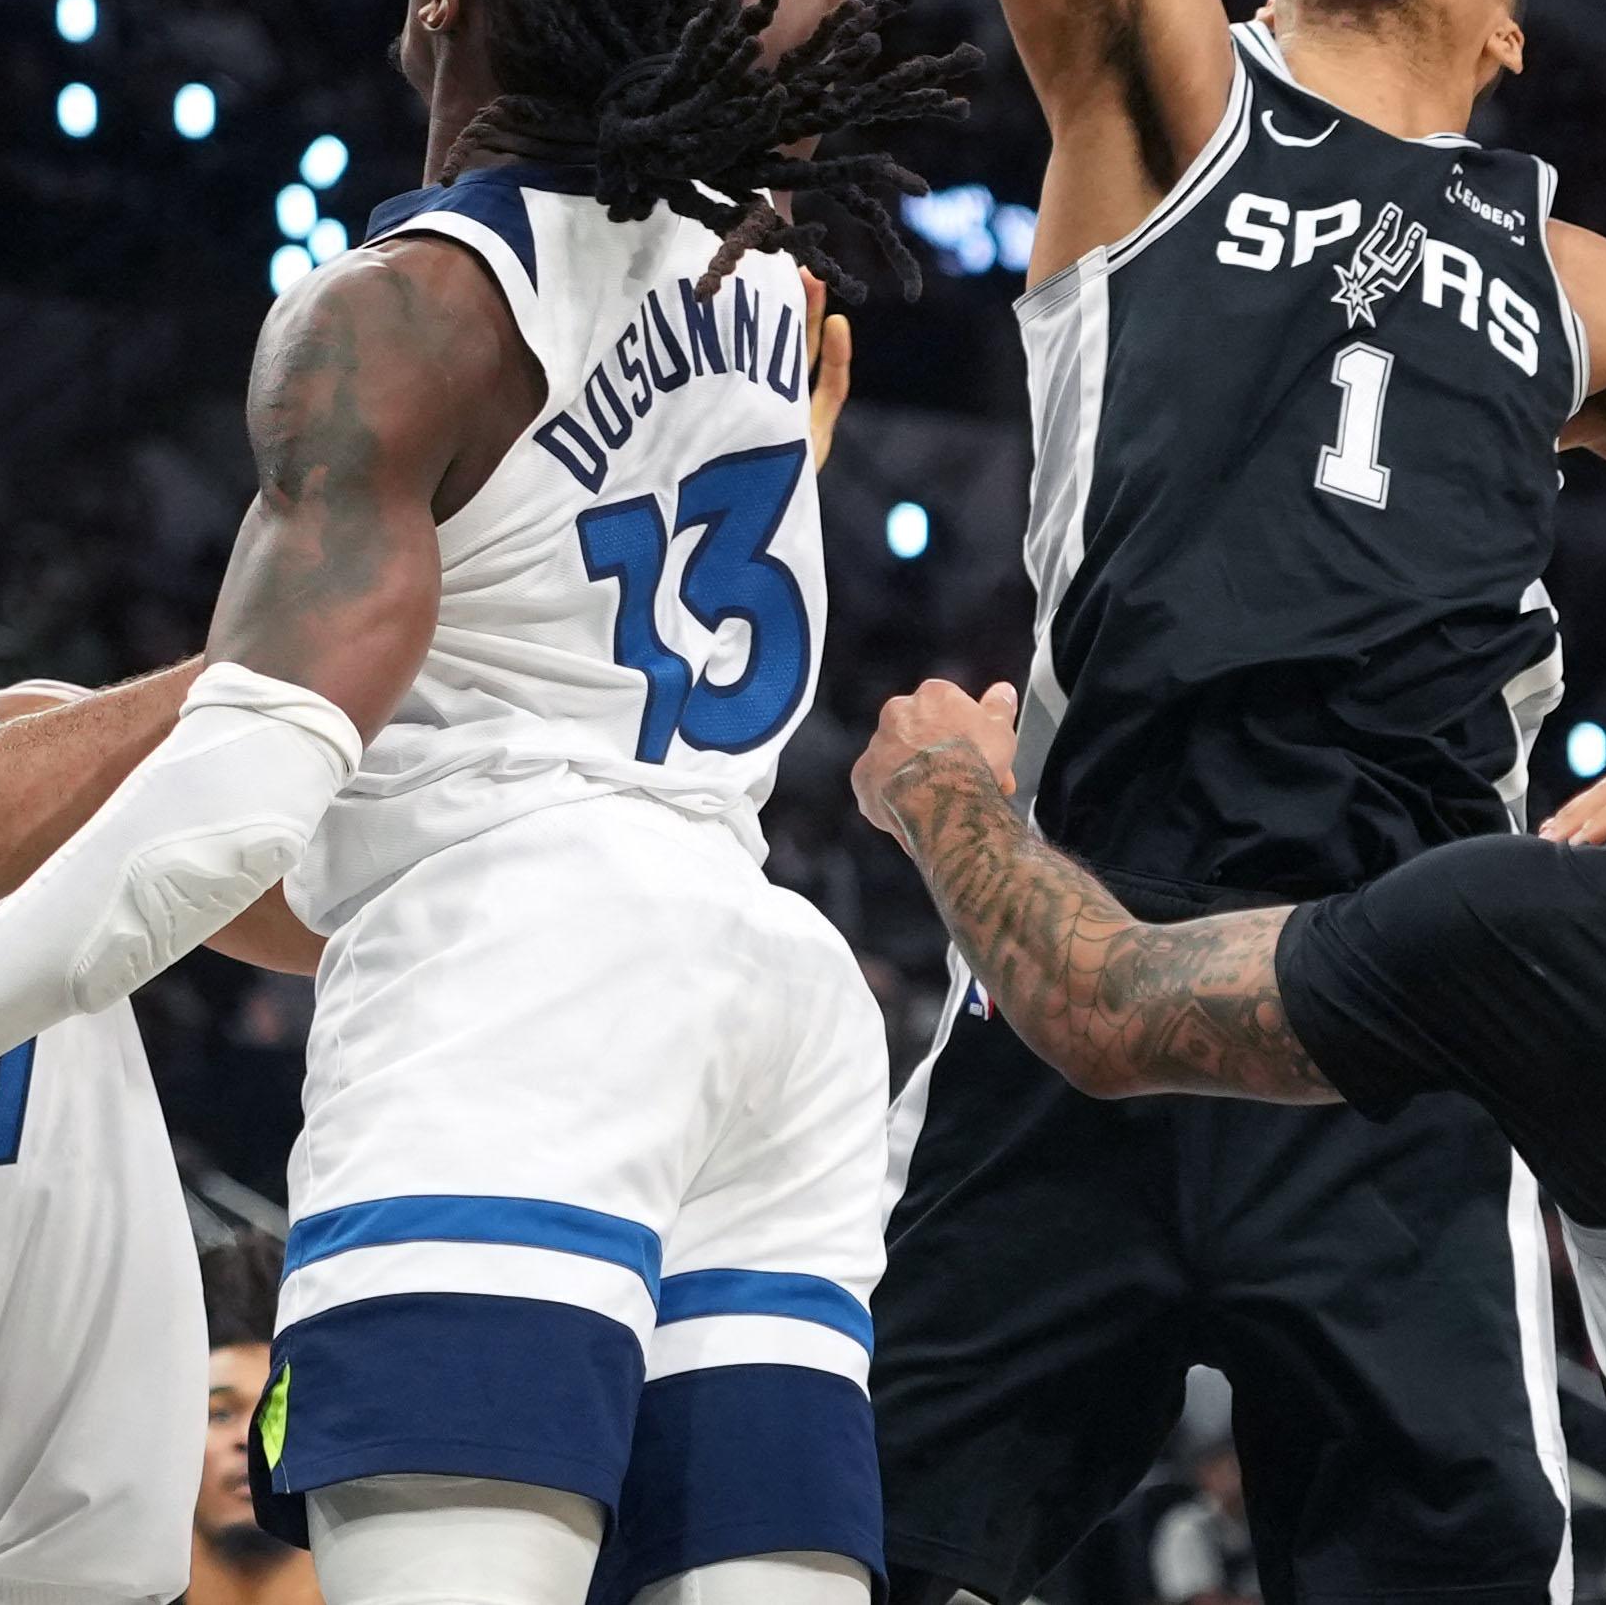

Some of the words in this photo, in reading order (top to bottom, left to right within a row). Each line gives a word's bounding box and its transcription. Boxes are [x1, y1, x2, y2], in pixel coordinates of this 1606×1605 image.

[1216, 192, 1541, 378] SPURS
[1454, 180, 1515, 232] LEDGER
[1314, 341, 1395, 511] 1
[576, 439, 811, 764] 13
